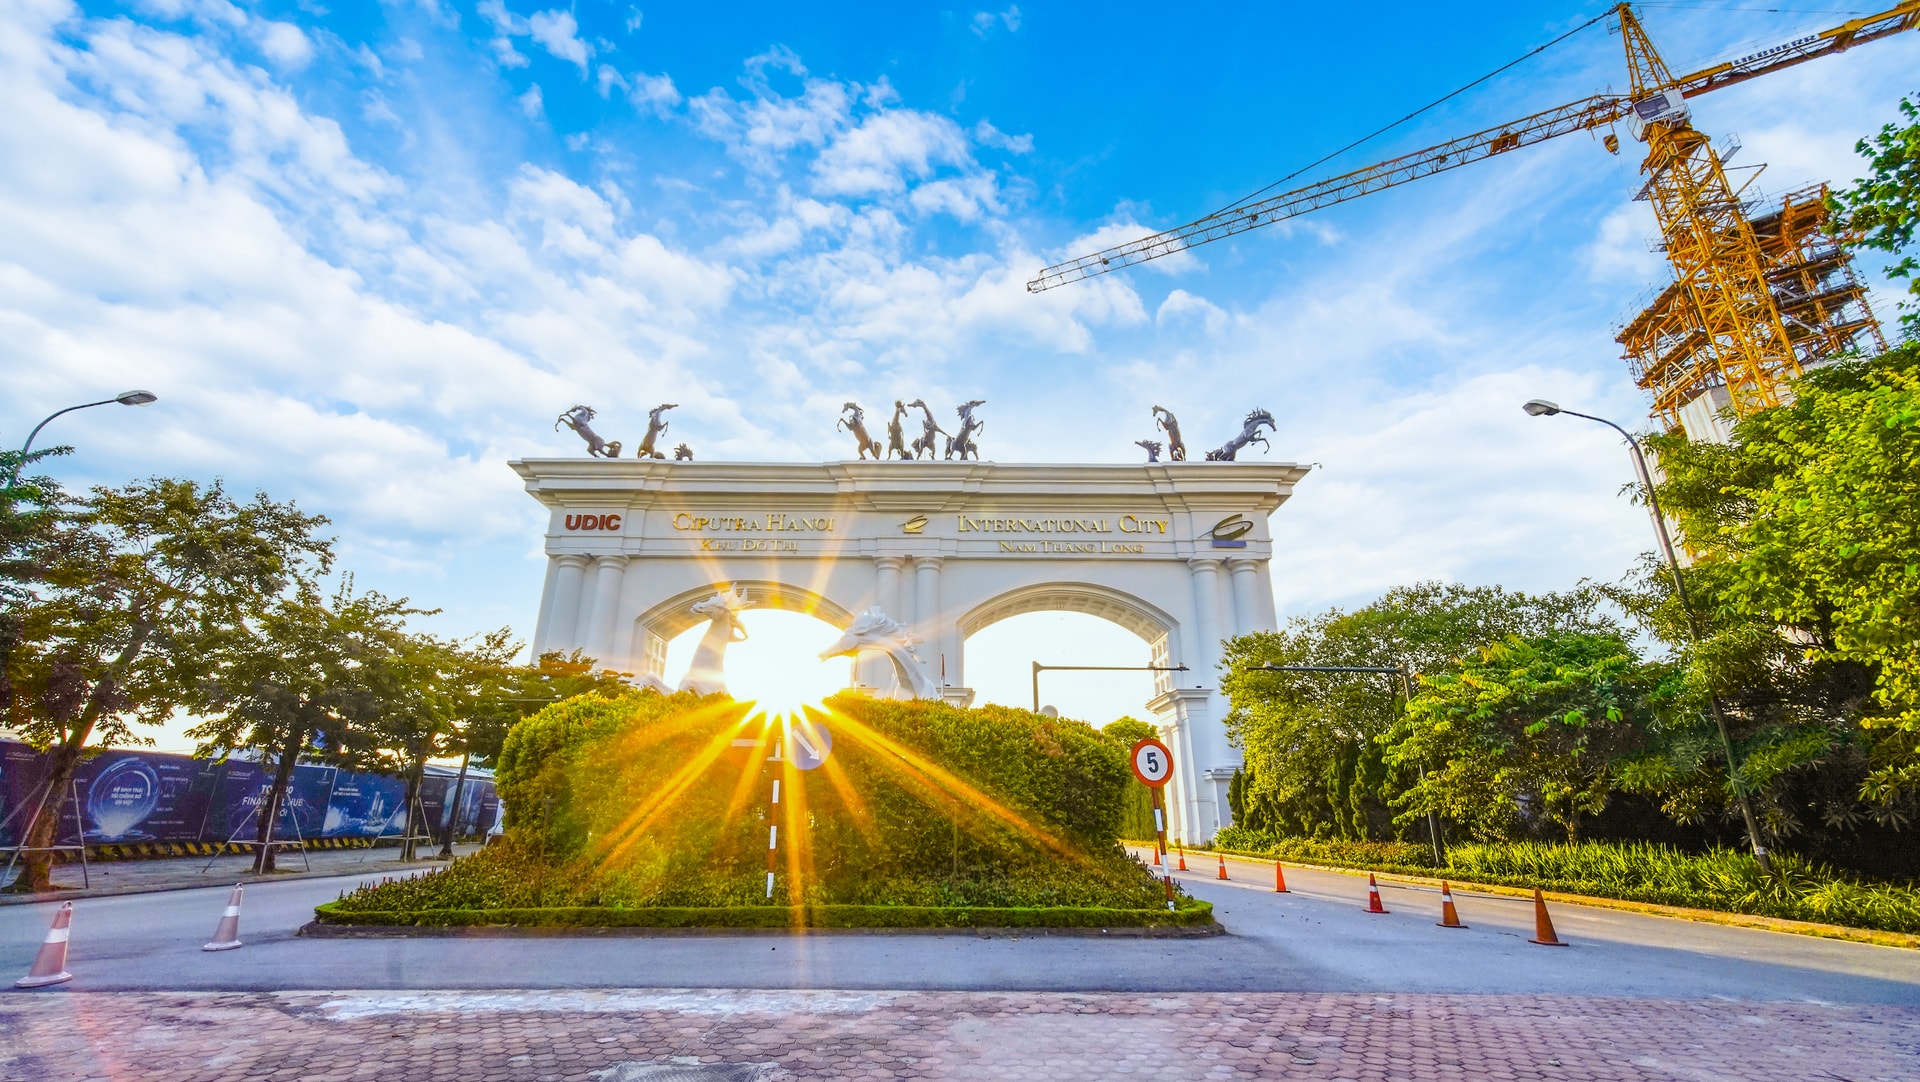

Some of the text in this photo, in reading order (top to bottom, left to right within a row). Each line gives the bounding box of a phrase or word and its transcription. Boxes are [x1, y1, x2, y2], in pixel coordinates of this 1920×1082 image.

[565, 514, 621, 530] UDIC
[672, 513, 835, 531] CIPUTRA HANOI
[957, 514, 1169, 534] INTERNATIONAL CITY
[1000, 540, 1036, 553] NAM
[1101, 540, 1145, 554] LONG
[1146, 752, 1159, 773] 5
